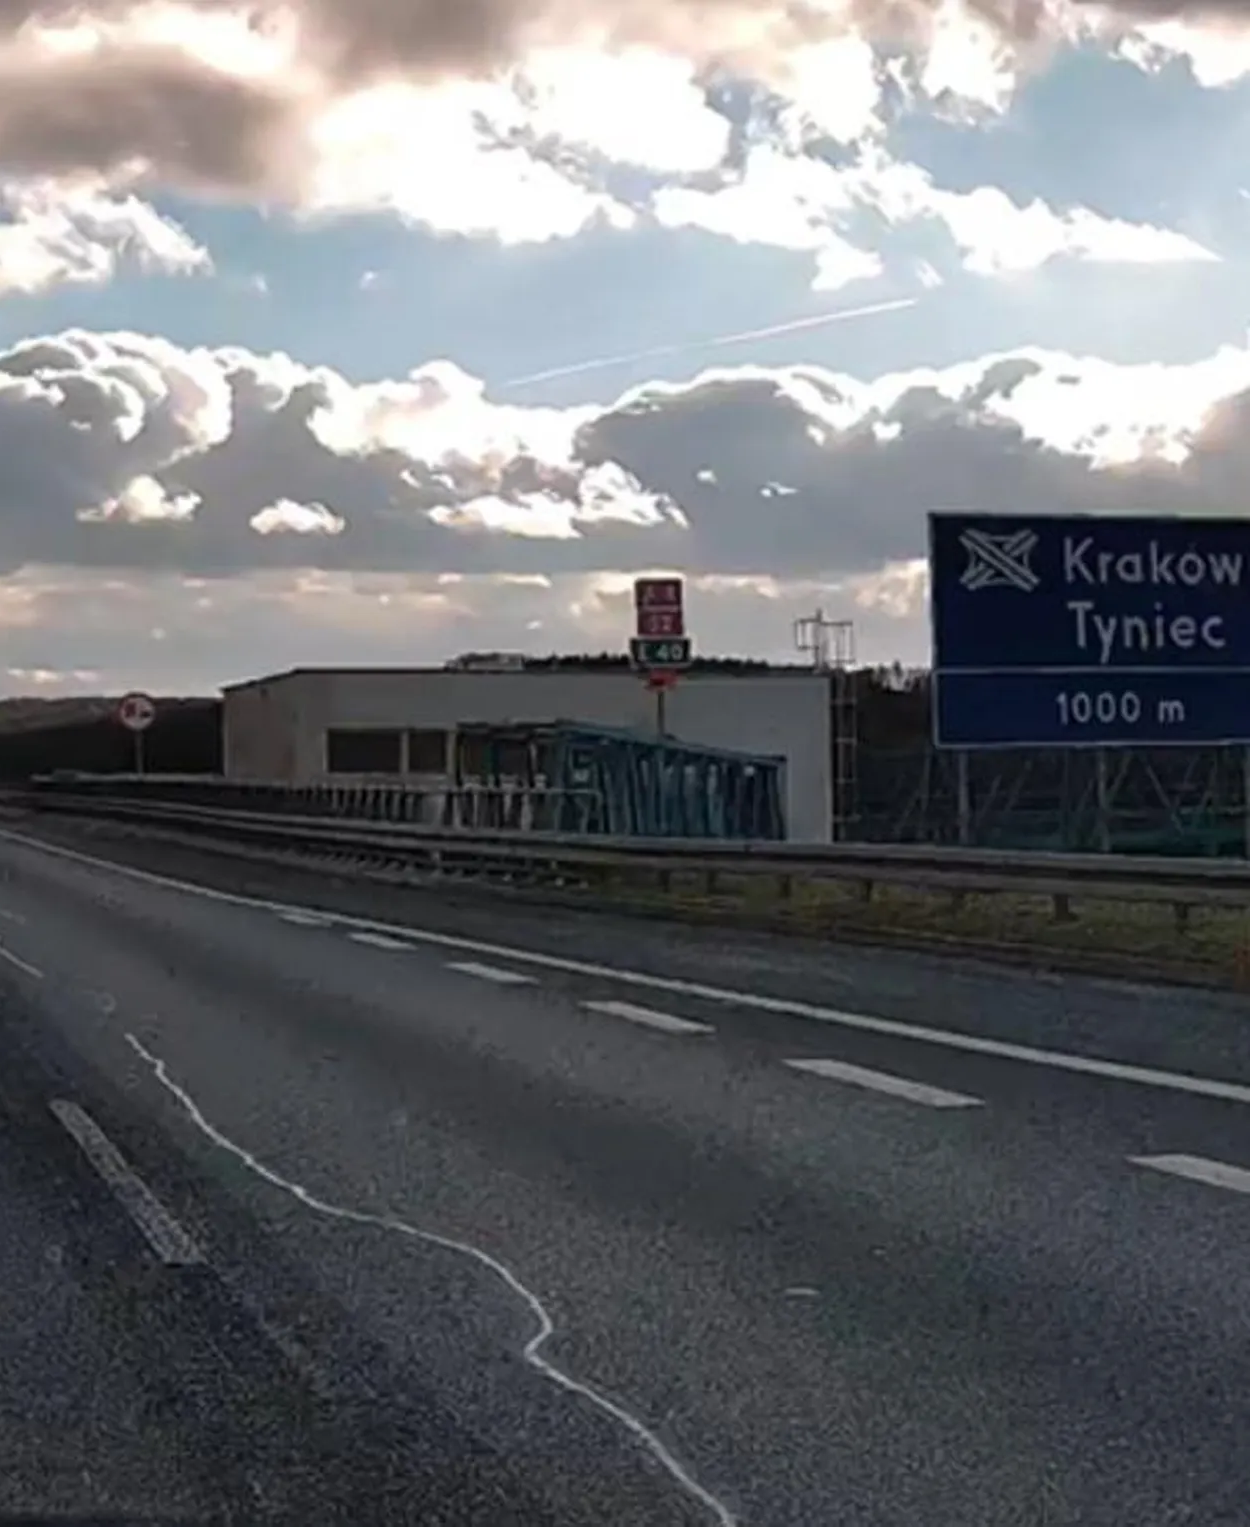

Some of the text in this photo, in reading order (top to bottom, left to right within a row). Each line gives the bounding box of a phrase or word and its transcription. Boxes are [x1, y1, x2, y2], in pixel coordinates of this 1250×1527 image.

[1063, 536, 1243, 585] Kraków
[656, 643, 684, 661] 40
[1066, 601, 1226, 664] Tyniec
[1055, 692, 1185, 724] 1000 m
